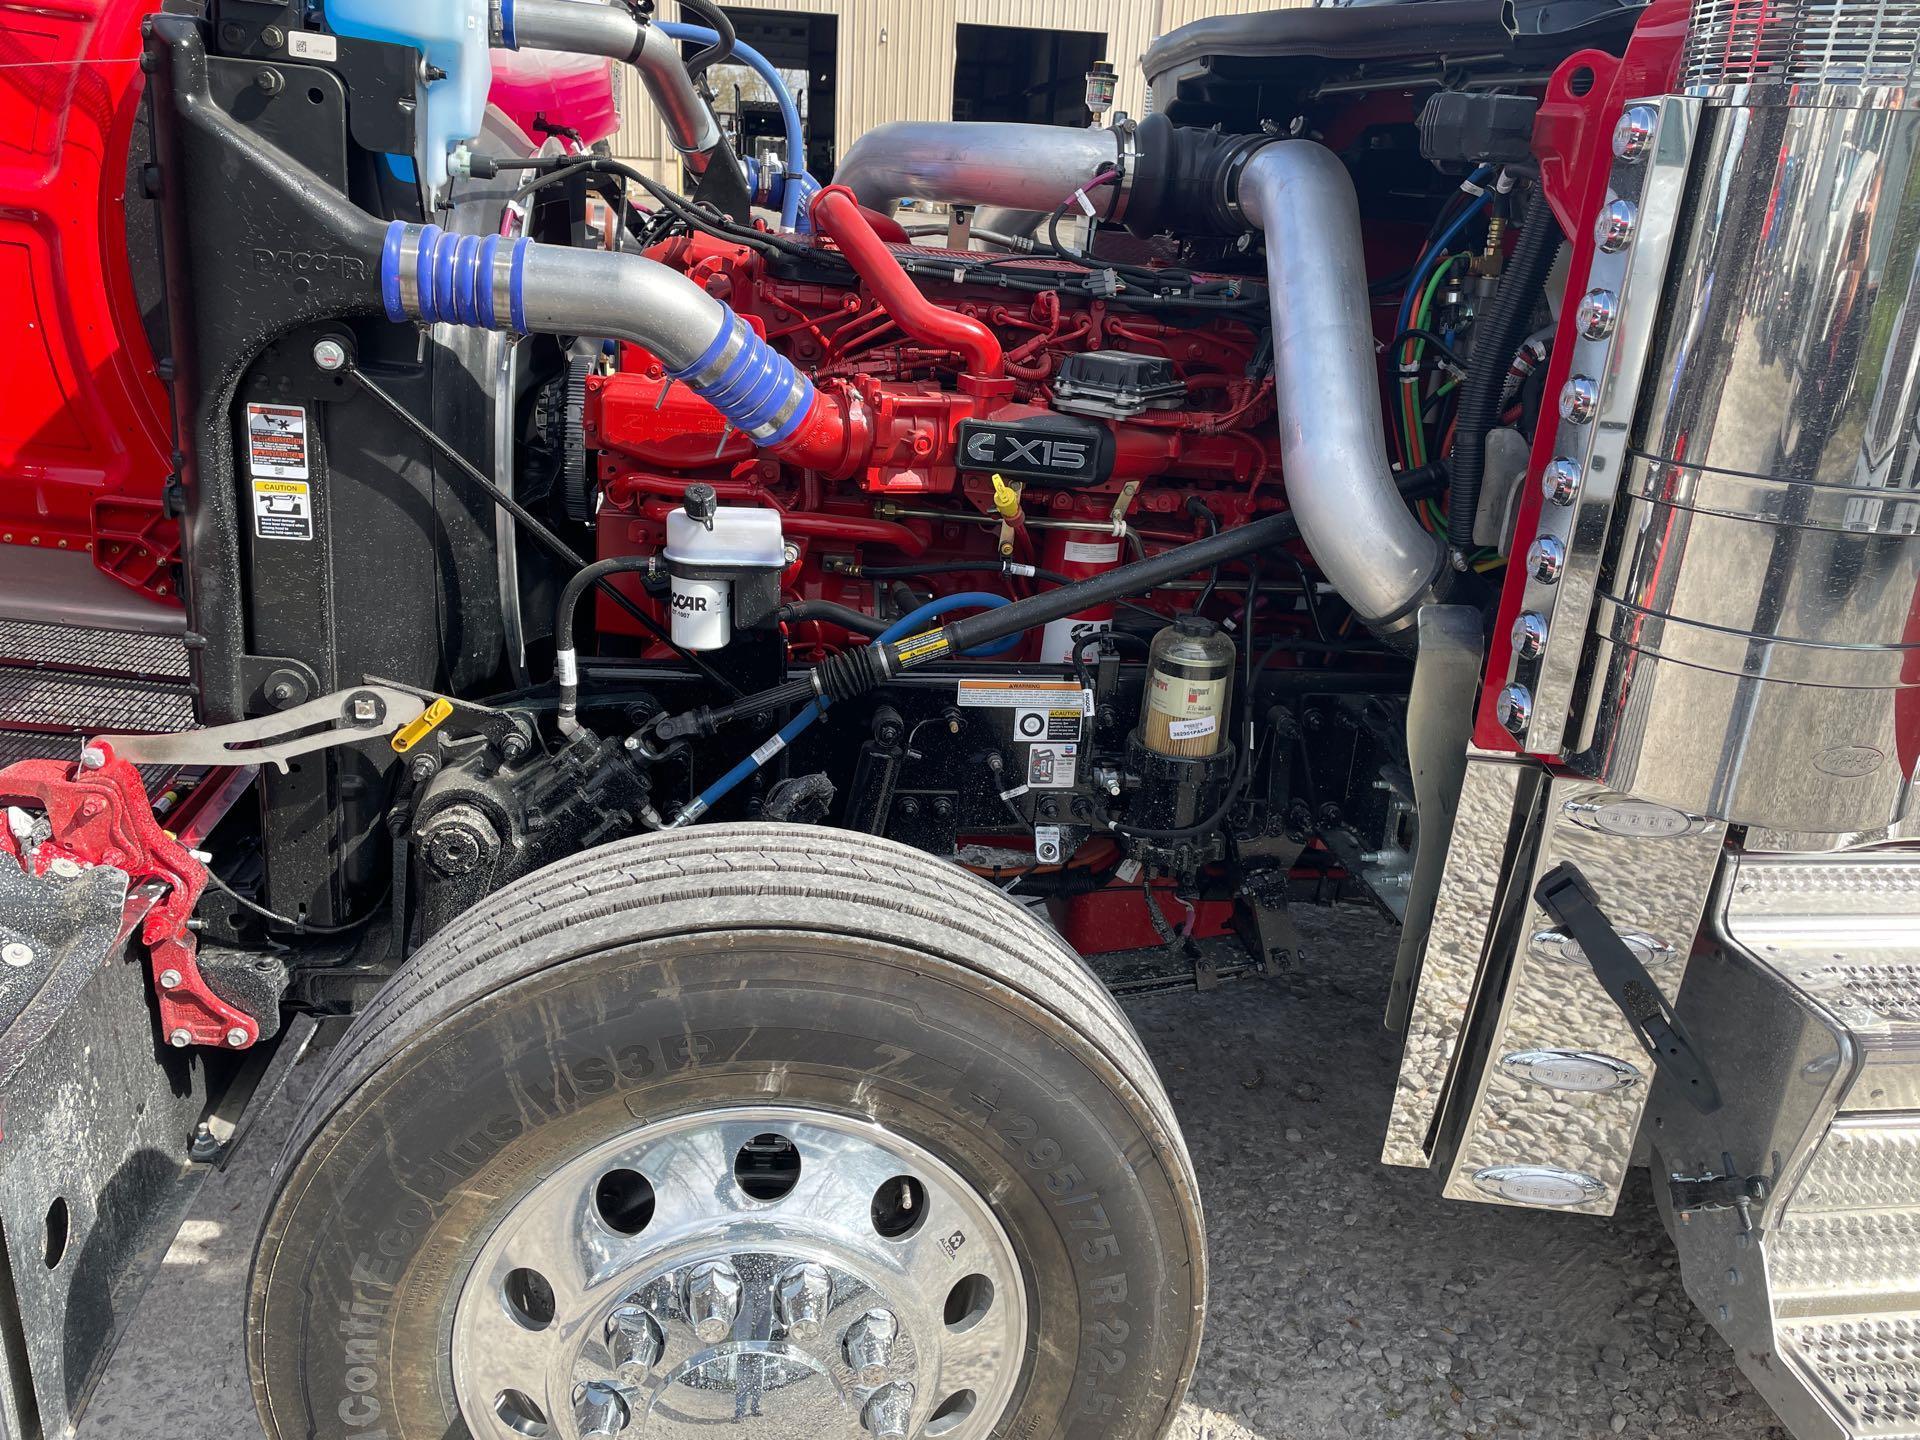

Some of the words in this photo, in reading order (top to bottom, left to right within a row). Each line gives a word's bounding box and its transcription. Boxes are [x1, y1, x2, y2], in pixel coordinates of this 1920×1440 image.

[253, 247, 365, 281] PACCAR
[1001, 436, 1087, 469] X15
[264, 483, 298, 492] CAUTION
[1001, 1113, 1122, 1264] 295/75
[939, 1237, 956, 1261] ALCOA
[1089, 1272, 1129, 1305] R
[1081, 1319, 1131, 1416] 22.5
